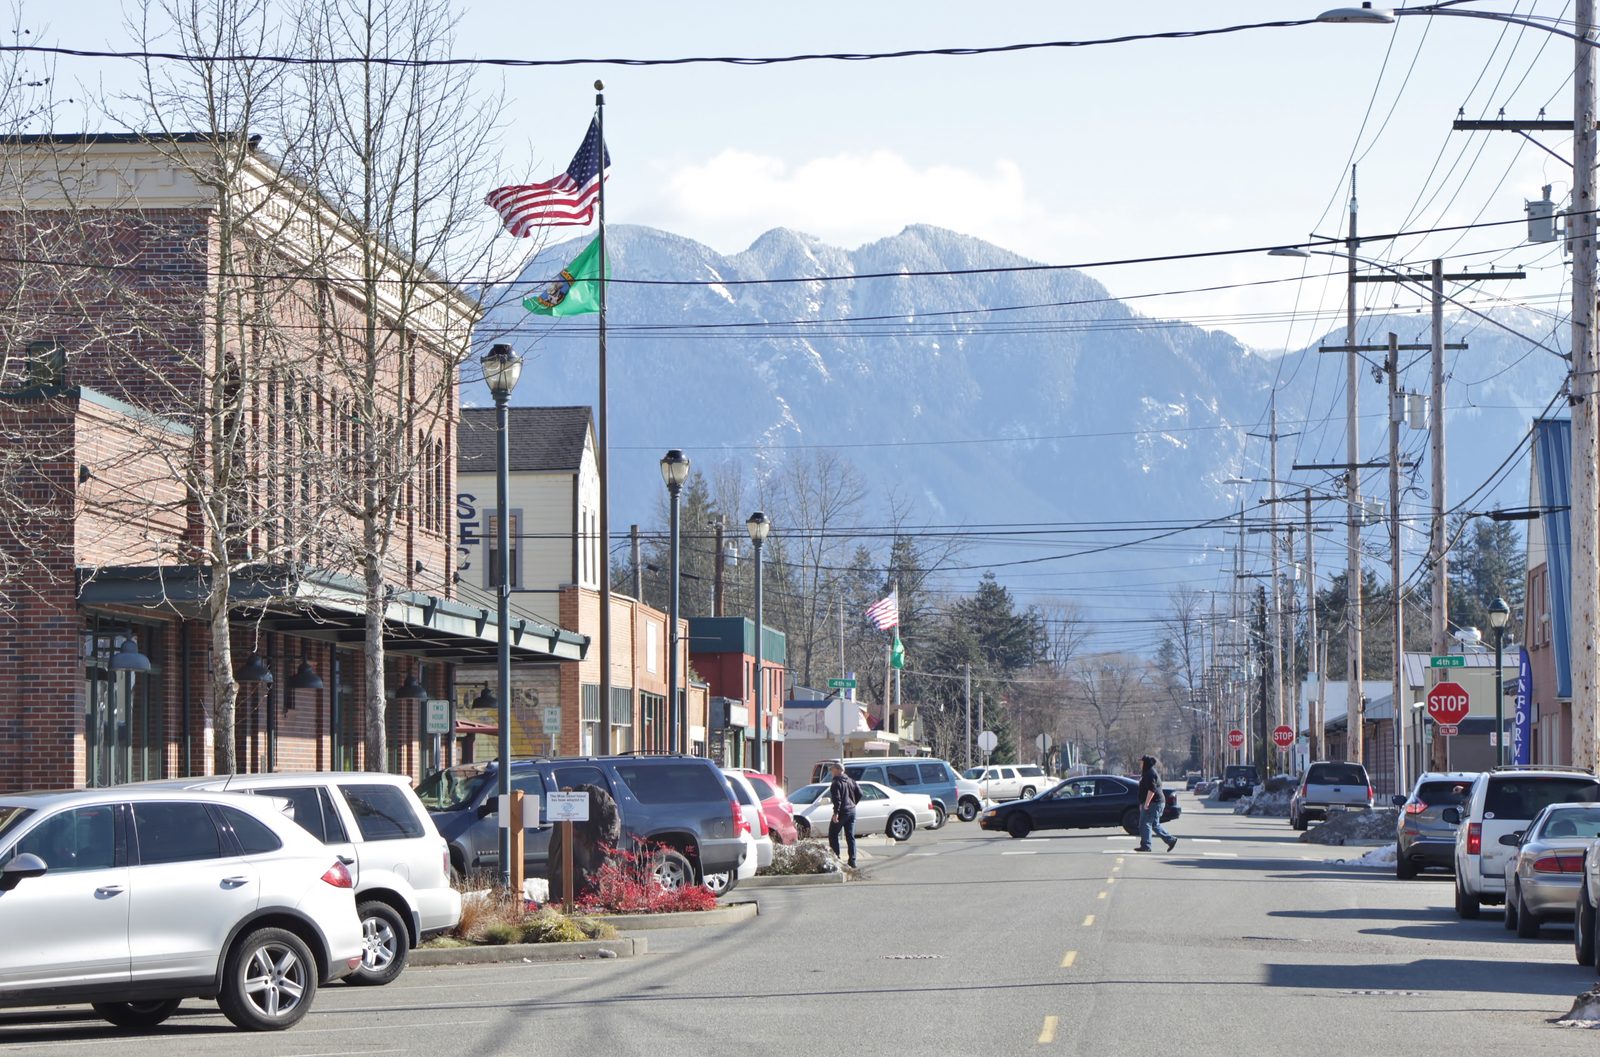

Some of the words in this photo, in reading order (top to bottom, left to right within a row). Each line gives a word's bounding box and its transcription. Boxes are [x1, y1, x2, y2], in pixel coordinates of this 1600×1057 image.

[1430, 695, 1467, 712] STOP
[1228, 734, 1244, 742] STOP
[1274, 731, 1293, 741] STOP
